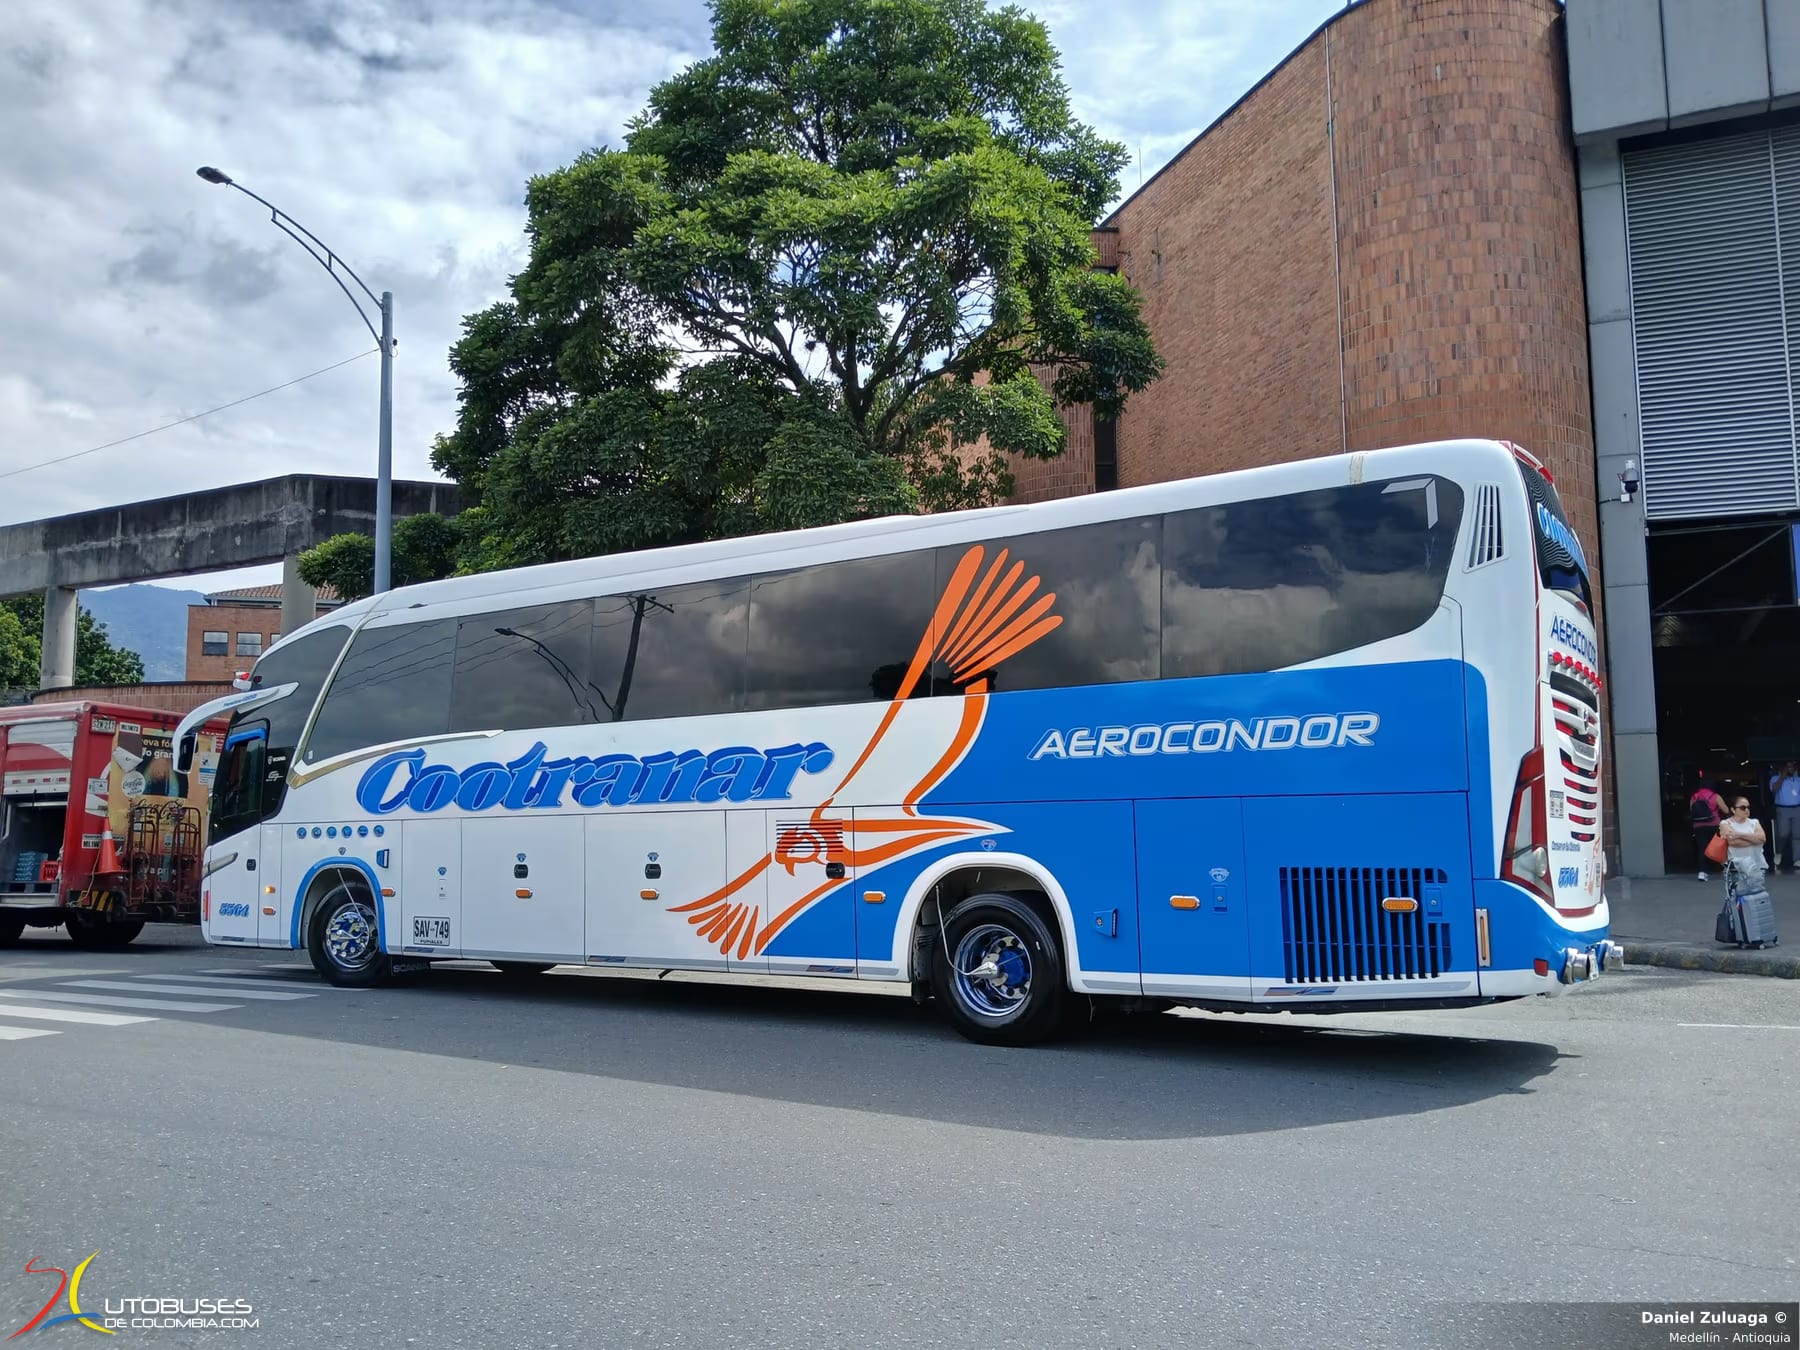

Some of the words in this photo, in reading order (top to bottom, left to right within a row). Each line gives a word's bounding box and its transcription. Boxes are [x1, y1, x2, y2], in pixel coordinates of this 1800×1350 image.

[1026, 711, 1380, 760] AEROCONDOR
[356, 740, 835, 814] Cootranar
[414, 919, 449, 938] SAV-749
